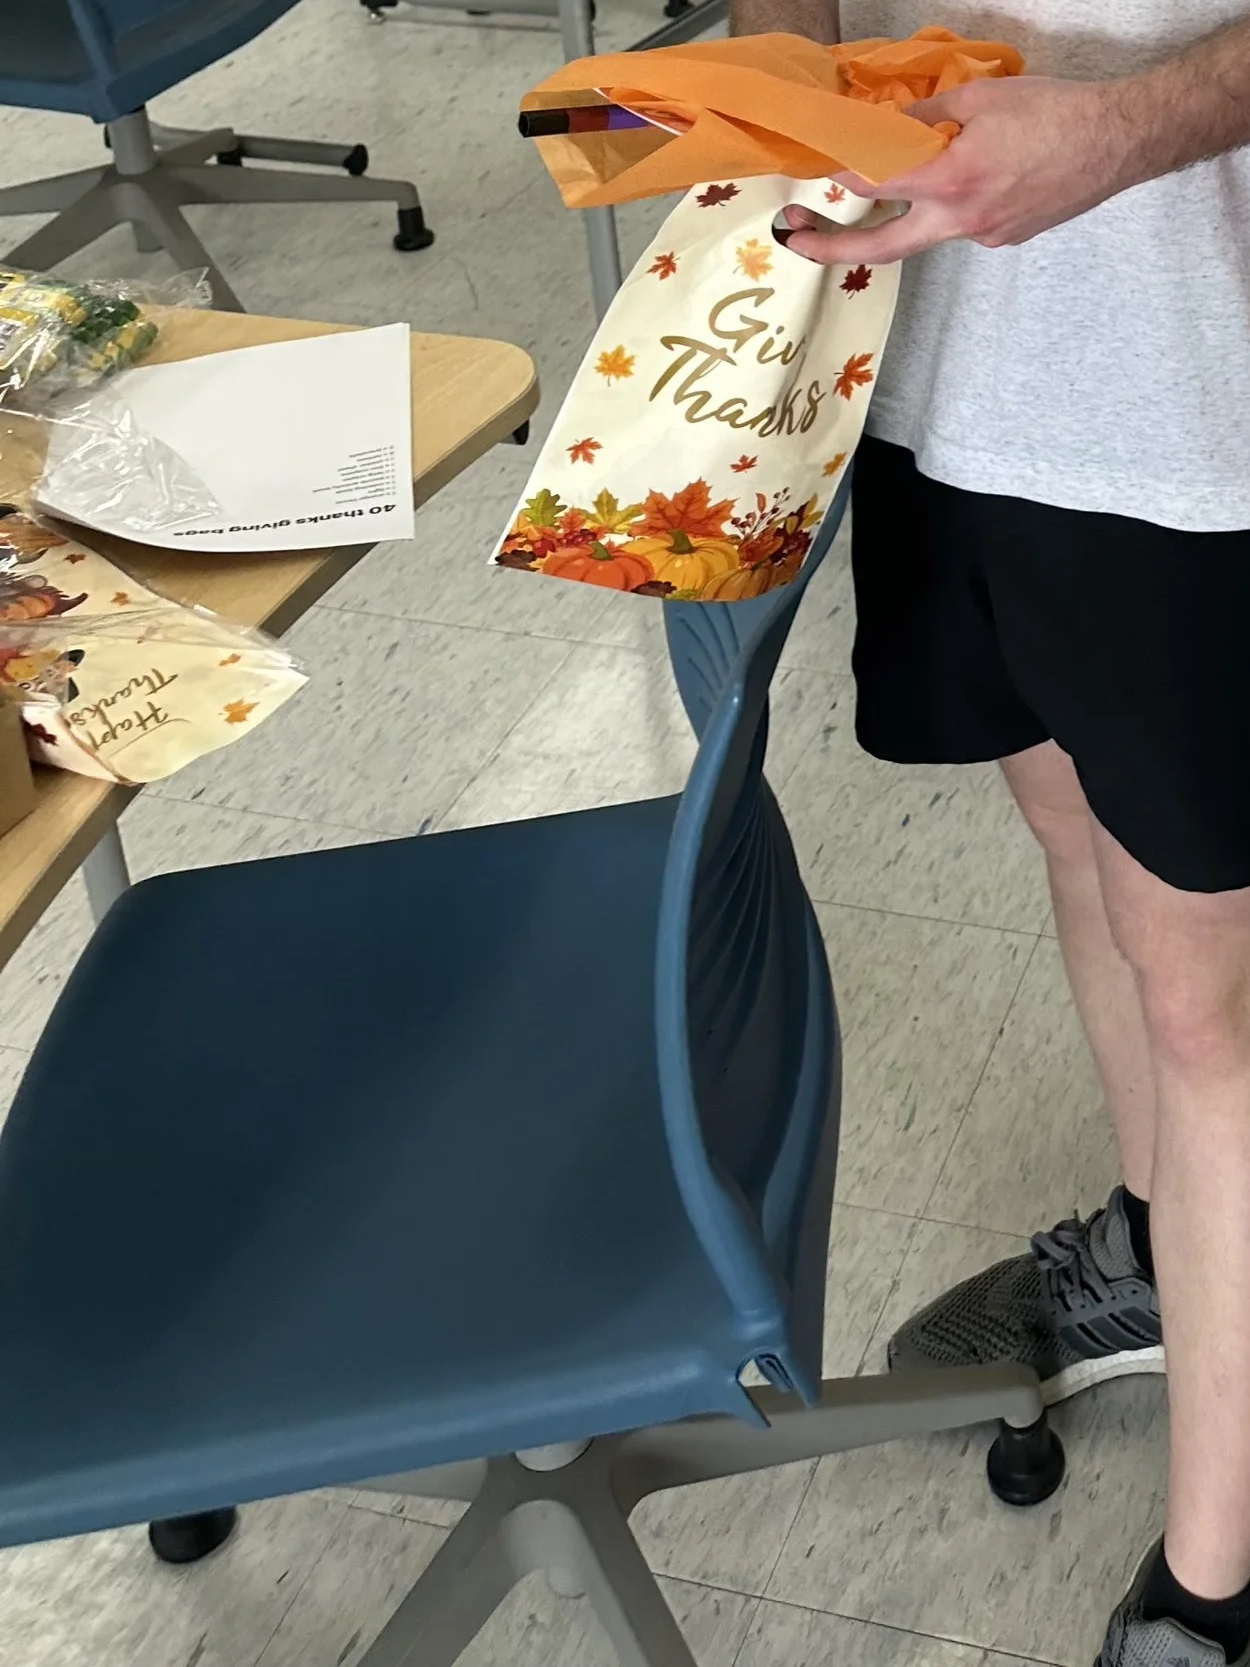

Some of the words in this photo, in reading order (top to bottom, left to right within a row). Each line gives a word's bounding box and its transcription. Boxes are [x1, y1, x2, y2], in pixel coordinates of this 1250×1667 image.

[708, 287, 806, 365] Giv
[649, 335, 833, 438] Thanks
[296, 507, 365, 526] thanks
[369, 502, 397, 516] 40
[172, 527, 224, 538] bags
[228, 517, 291, 534] giving
